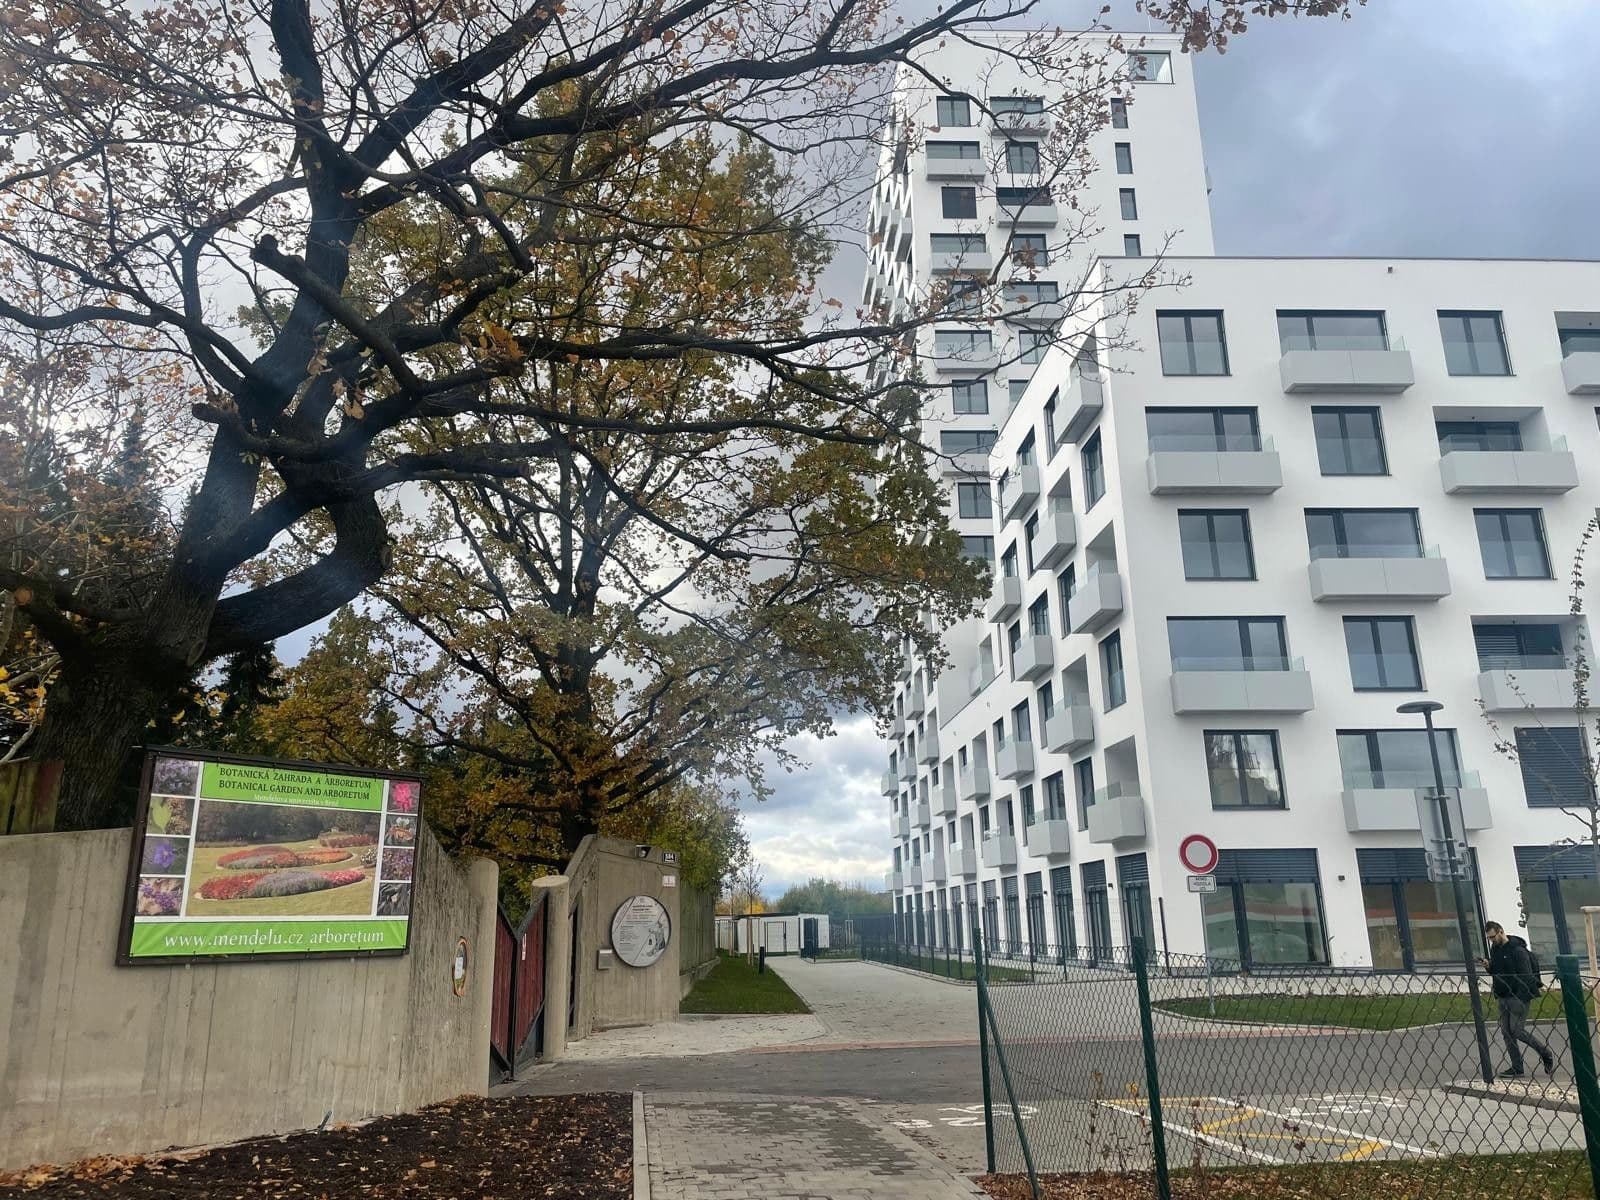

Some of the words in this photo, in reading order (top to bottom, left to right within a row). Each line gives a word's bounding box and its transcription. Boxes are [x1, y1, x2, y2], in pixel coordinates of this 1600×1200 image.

[219, 767, 270, 780] BOTANICKÁ
[315, 777, 321, 785] A
[324, 778, 371, 790] ARBORETUM
[218, 780, 268, 792] BOTANICAL
[269, 785, 303, 795] GARDEN
[304, 787, 322, 796] AND
[323, 789, 370, 801] ARBORETUM
[164, 928, 304, 948] www.mendelu.cz
[309, 928, 385, 945] arboretum
